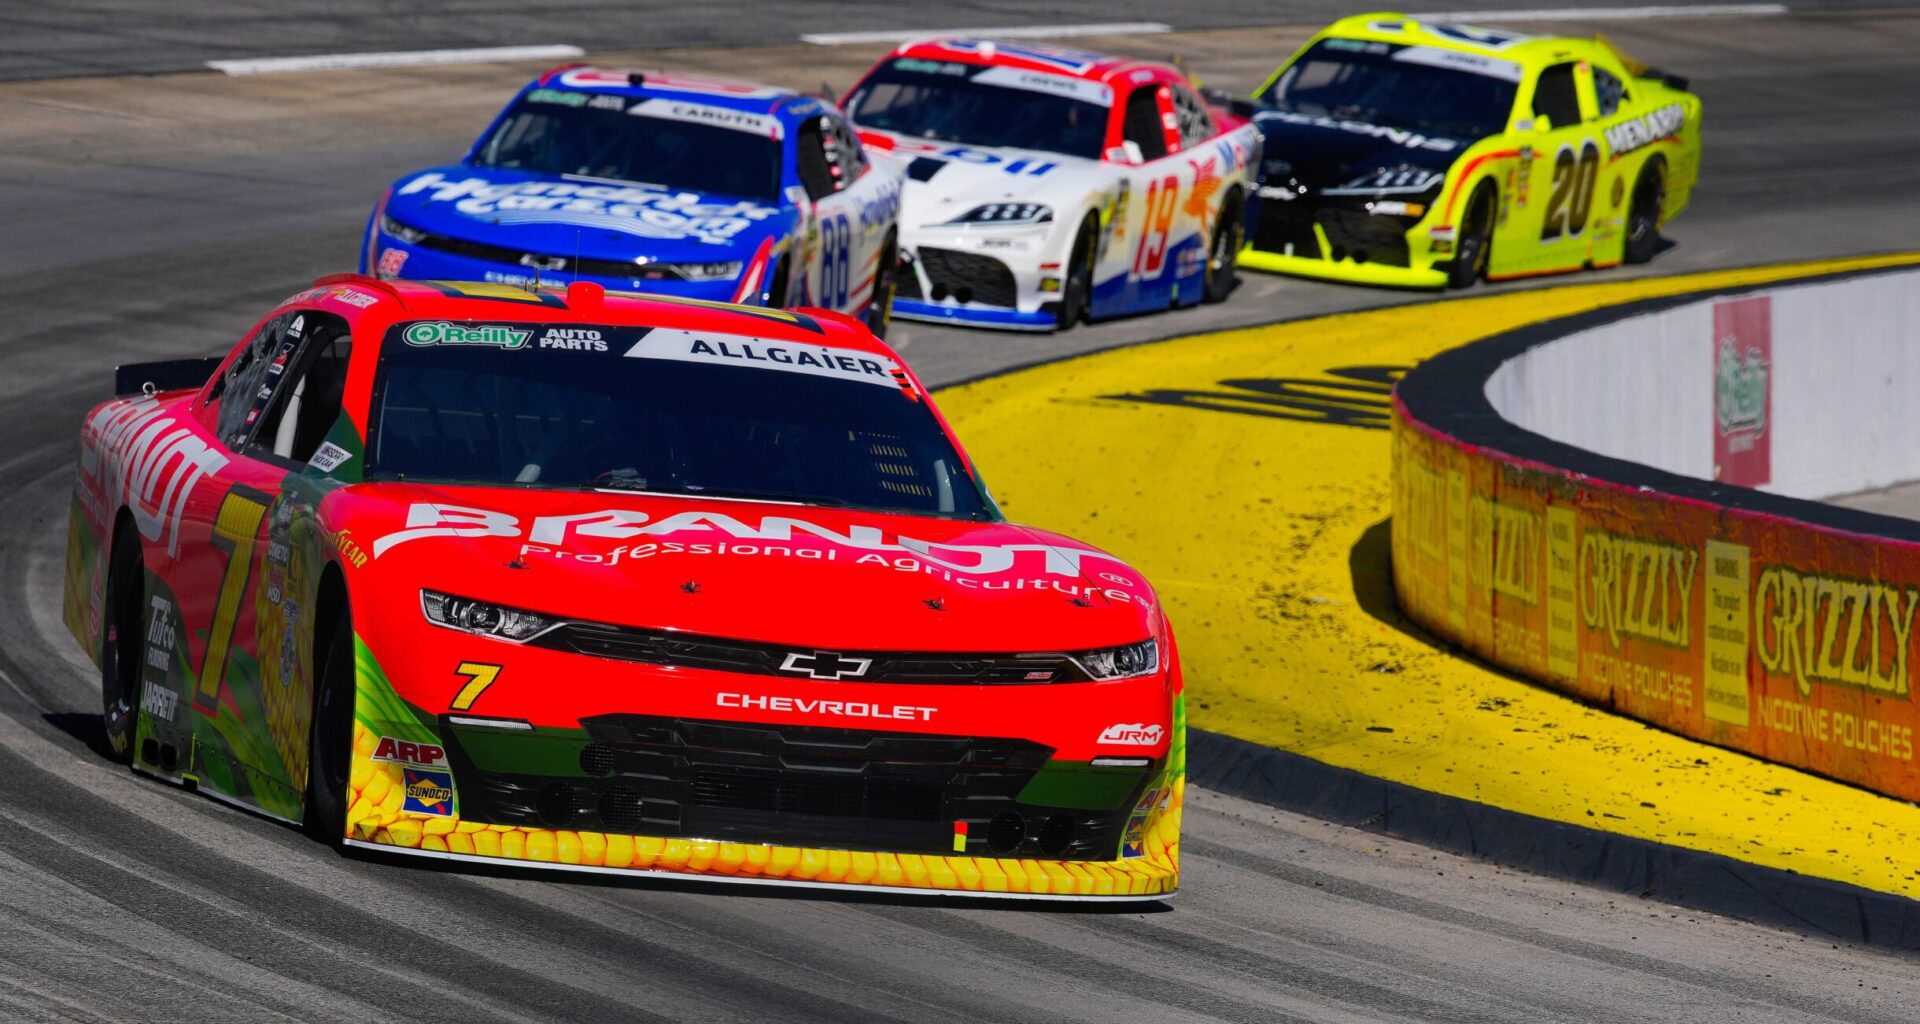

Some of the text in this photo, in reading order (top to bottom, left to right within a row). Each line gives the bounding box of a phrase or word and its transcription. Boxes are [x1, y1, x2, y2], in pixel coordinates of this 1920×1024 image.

[671, 105, 763, 128] CARUTH
[1539, 136, 1601, 244] 20
[1130, 175, 1180, 280] 19
[820, 213, 850, 310] 88
[407, 322, 527, 348] O'Reilly
[539, 337, 609, 352] PARTS
[545, 328, 601, 341] AUTO
[690, 338, 888, 378] ALLGAIER
[373, 503, 1136, 578] BRANDT
[196, 481, 276, 713] 7
[520, 541, 1131, 604] Professional Agriculture
[1579, 531, 1699, 650] GRIZZLY
[148, 594, 176, 651] Tufco
[1754, 566, 1919, 698] GRIZZLY
[448, 660, 504, 711] 7
[716, 692, 939, 722] CHEVROLET
[1583, 650, 1634, 693] NICOTINE
[1634, 663, 1693, 708] POUCHES
[373, 737, 445, 766] ARP
[1104, 730, 1159, 745] JRM
[1757, 694, 1829, 742] NICOTINE
[1832, 711, 1913, 761] POUCHES
[408, 785, 450, 801] SUNOCO
